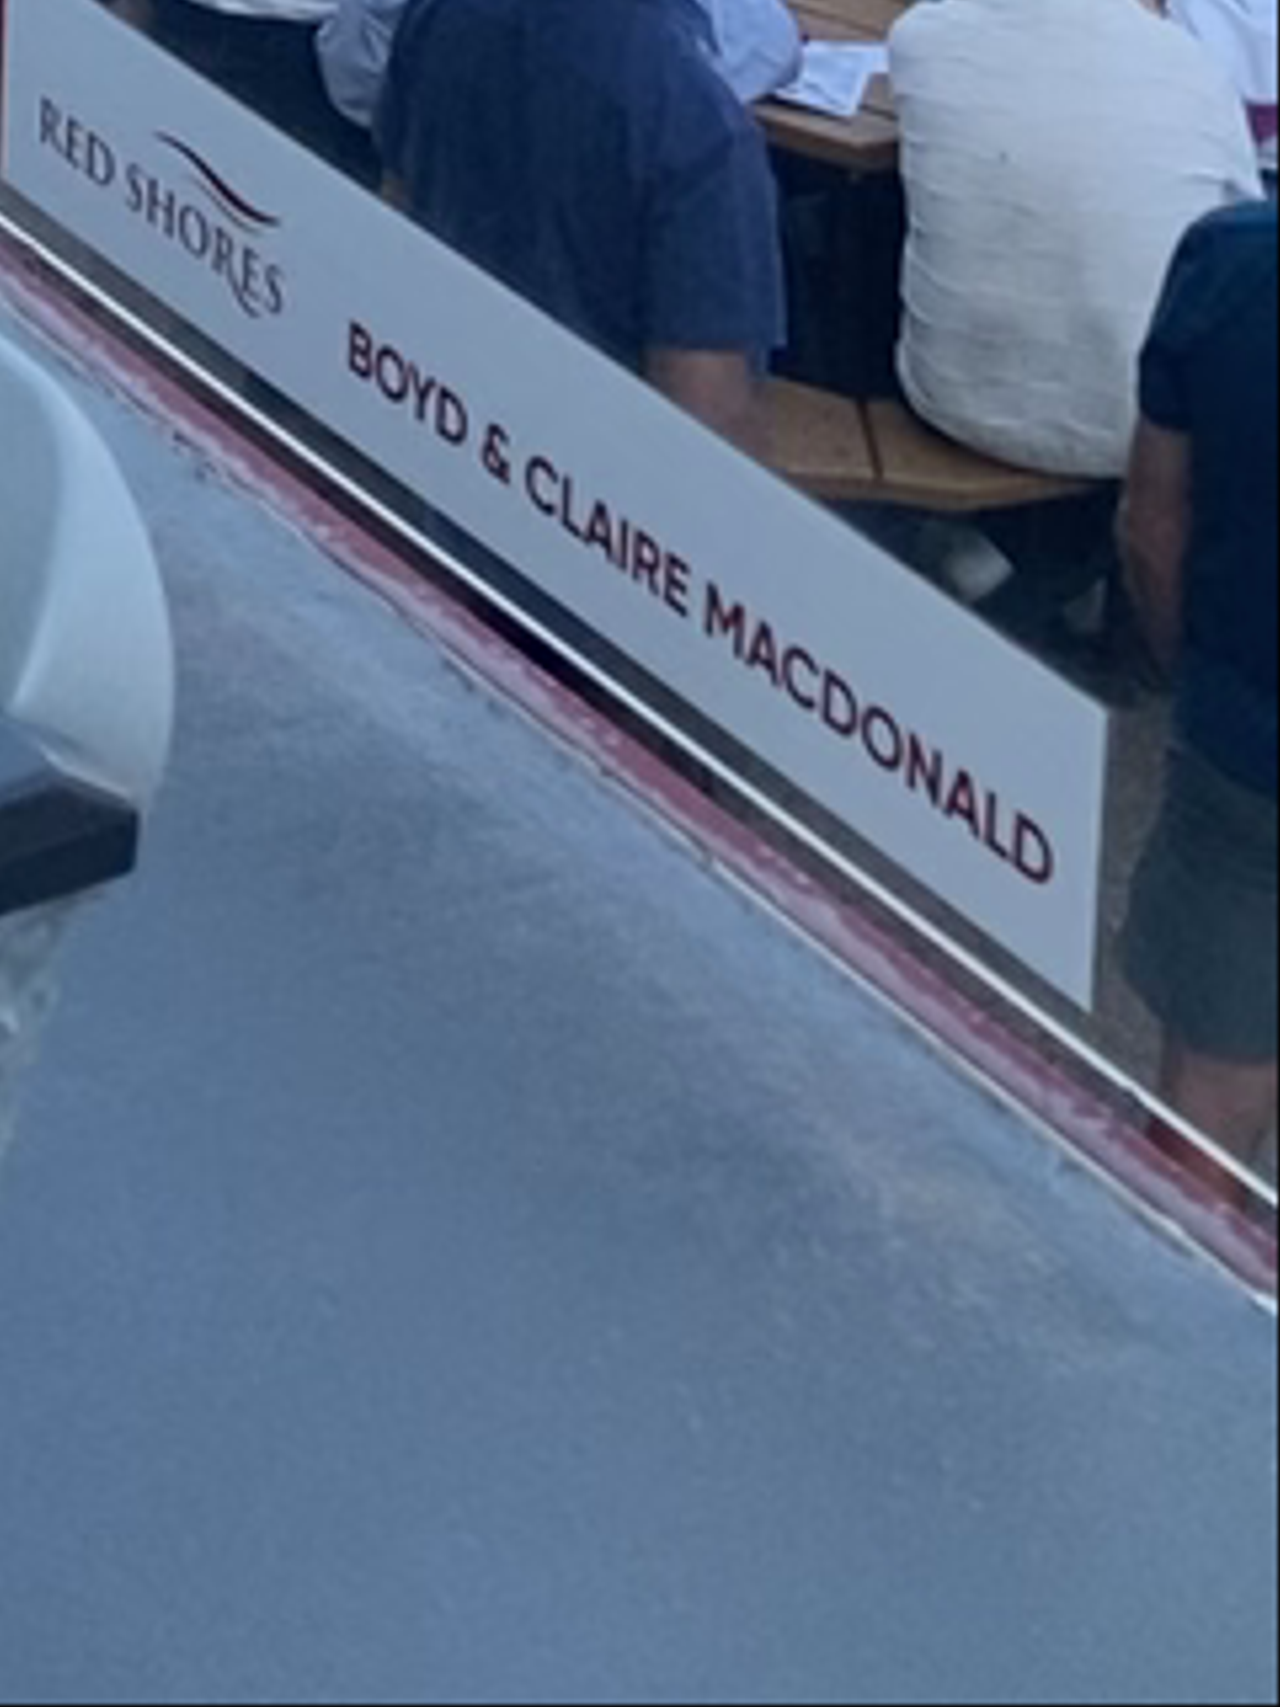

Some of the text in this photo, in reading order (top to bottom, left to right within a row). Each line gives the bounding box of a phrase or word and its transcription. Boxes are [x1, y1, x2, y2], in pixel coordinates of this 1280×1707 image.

[38, 95, 284, 318] RED SHORES
[347, 319, 1055, 885] BOYD & CLAIRE MACDONALD
